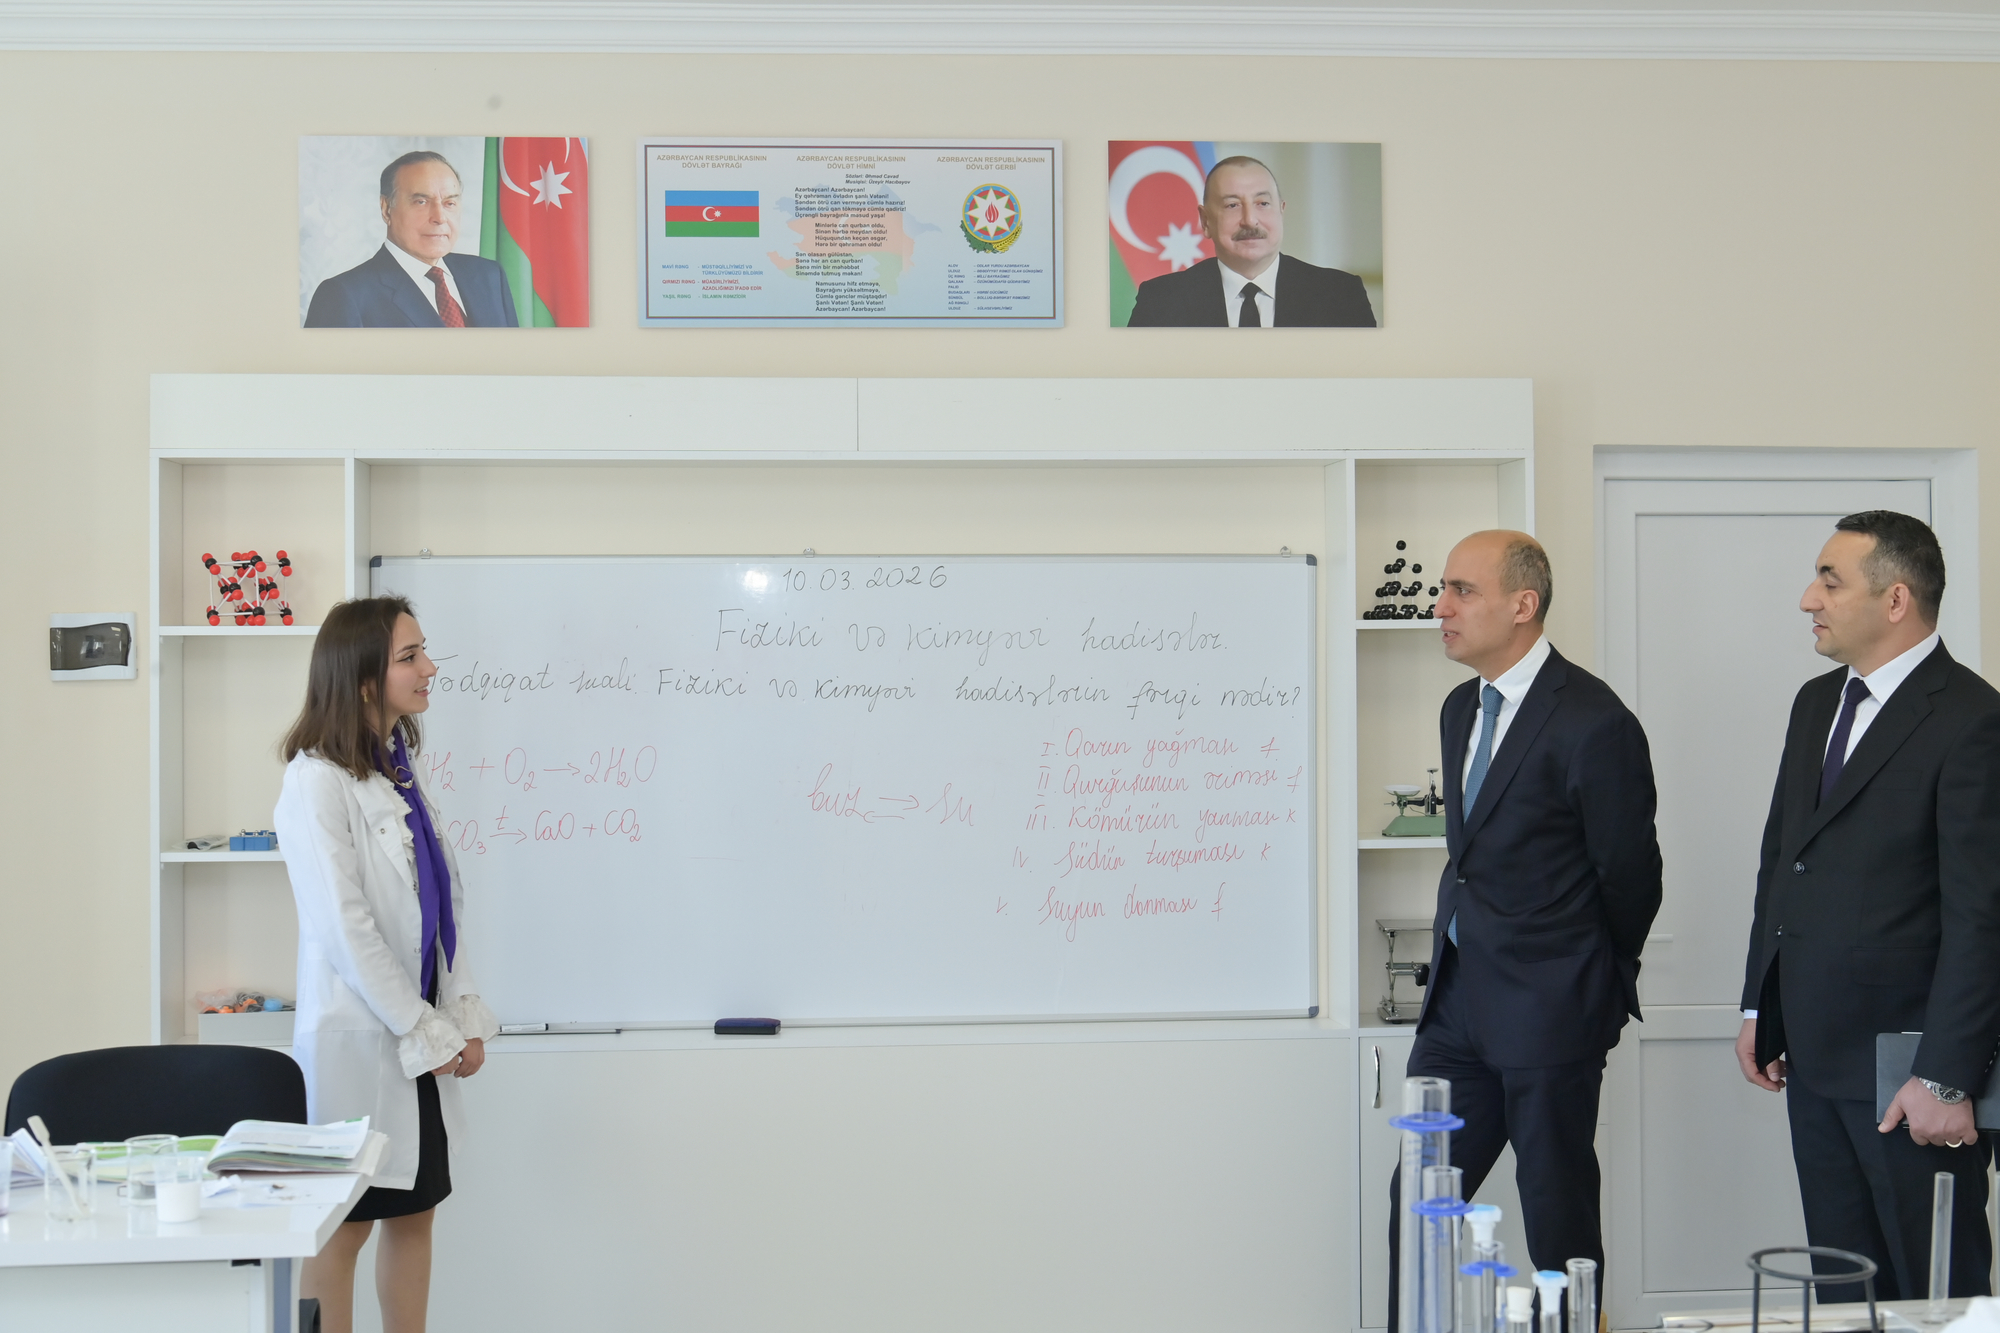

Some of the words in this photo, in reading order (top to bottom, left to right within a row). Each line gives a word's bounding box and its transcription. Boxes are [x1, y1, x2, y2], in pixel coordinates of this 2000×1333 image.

[716, 609, 824, 651] Fiziki
[848, 624, 886, 651] və
[1082, 612, 1228, 652] hadisələr.
[658, 668, 748, 696] Fiziki
[769, 678, 798, 698] və
[955, 674, 1110, 706] hadisələrin
[1127, 680, 1202, 720] fərqi
[1220, 677, 1302, 719] nədir?
[1064, 728, 1132, 757] Qarın
[1142, 728, 1238, 768] yağması
[808, 763, 864, 818] buz
